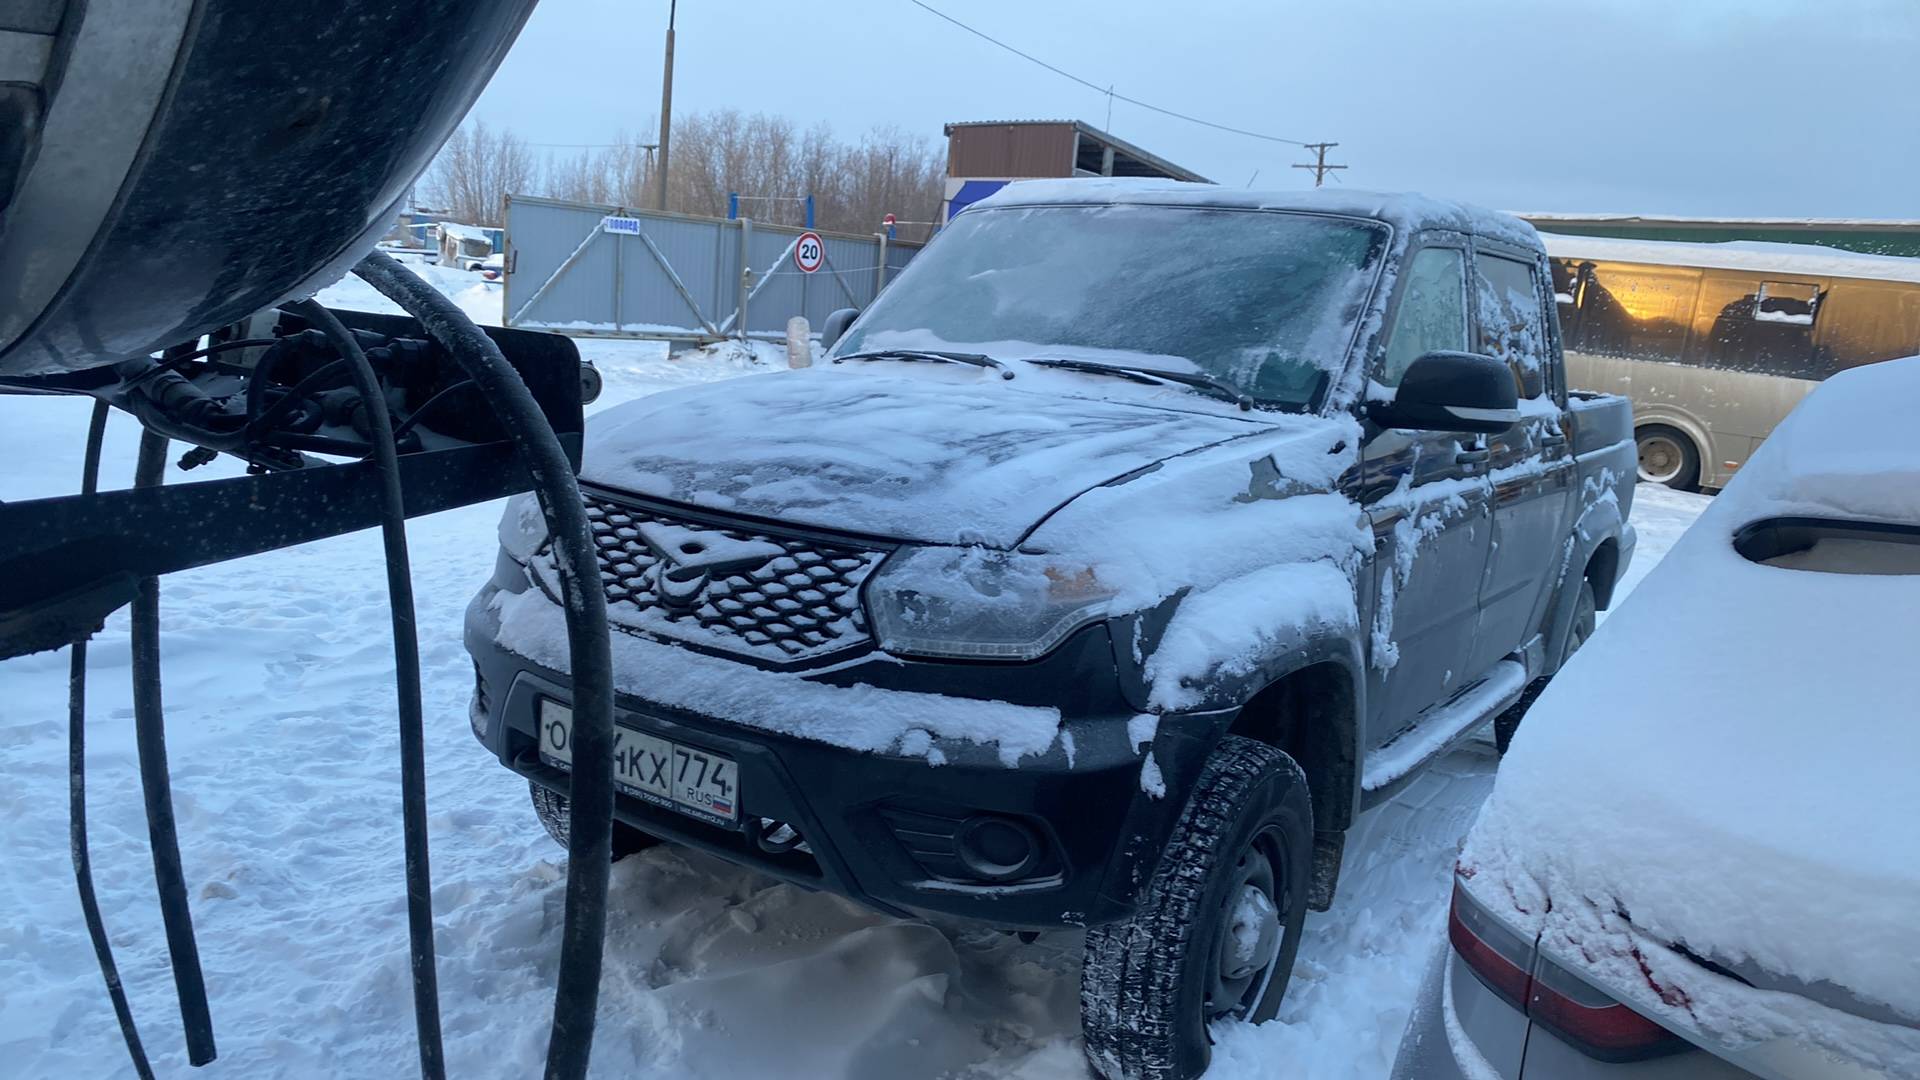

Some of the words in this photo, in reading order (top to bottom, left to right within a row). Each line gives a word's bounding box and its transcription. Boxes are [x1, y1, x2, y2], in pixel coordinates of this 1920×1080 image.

[801, 244, 818, 260] 20
[676, 750, 727, 796] 774
[687, 787, 713, 806] RUS
